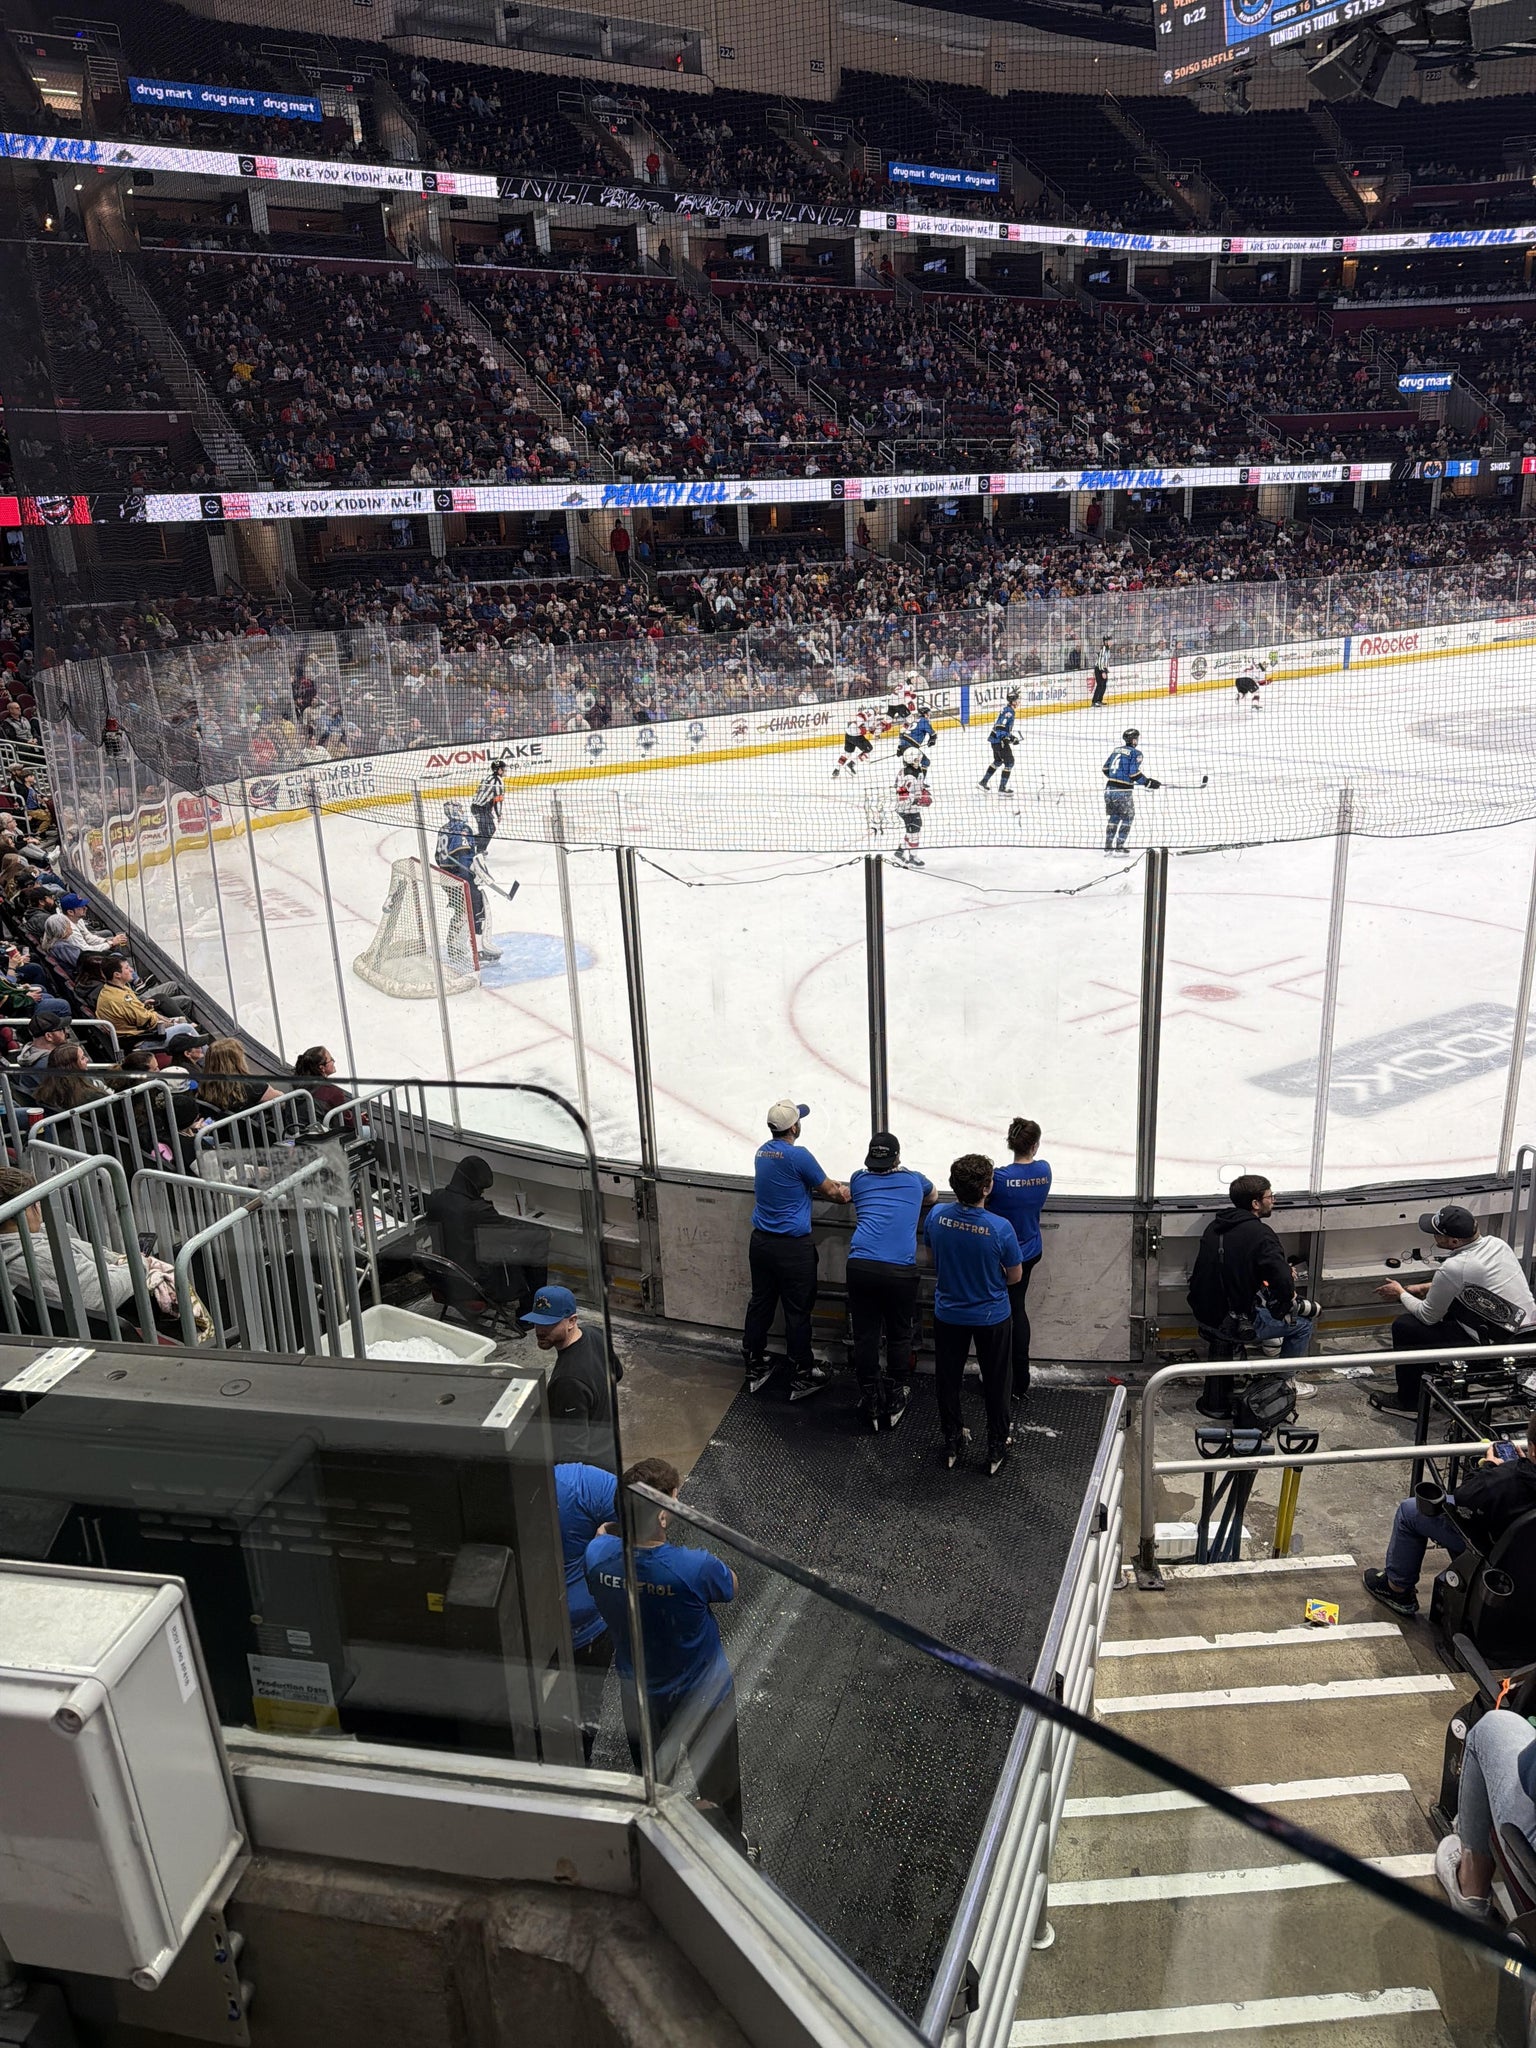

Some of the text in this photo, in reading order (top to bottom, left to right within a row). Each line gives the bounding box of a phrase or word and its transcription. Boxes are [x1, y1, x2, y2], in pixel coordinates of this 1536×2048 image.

[1159, 7, 1206, 34] 12 0:22
[1273, 7, 1297, 22] SHOTS
[1299, 1, 1310, 13] 16
[1269, 20, 1311, 47] TONIGHT'S
[1313, 10, 1339, 31] TOTAL
[721, 48, 735, 58] 224
[811, 61, 824, 71] 225
[1174, 62, 1200, 79] 50/50
[1201, 49, 1234, 69] RAFFLE
[136, 83, 315, 113] drug mart drug mart drug mart
[290, 165, 313, 178] ARE
[317, 168, 339, 180] YOU
[344, 170, 381, 183] KIDDIN'
[387, 171, 412, 187] ME!!
[893, 166, 995, 186] drug mart drug mart drug mart
[916, 221, 931, 231] ARE
[934, 223, 948, 232] YOU
[1250, 242, 1264, 251] ARE
[1267, 241, 1280, 250] YOU
[1398, 374, 1452, 390] drug mart
[1267, 472, 1280, 481] ARE
[1283, 471, 1295, 481] YOU
[1459, 462, 1472, 475] 16
[1490, 462, 1510, 472] SHOTS
[871, 484, 889, 495] ARE
[894, 482, 911, 493] YOU
[950, 477, 970, 491] ME!!
[1079, 470, 1164, 490] PENALTY KILL
[267, 500, 295, 514] ARE
[302, 500, 328, 512] YOU
[335, 498, 382, 511] KIDDIN'
[391, 491, 422, 509] ME!!
[601, 481, 730, 508] PENALTY KILL
[1373, 632, 1419, 656] Rocket
[1434, 636, 1447, 648] nrg
[1466, 631, 1480, 644] nrg
[1046, 687, 1067, 701] slaps
[1110, 753, 1121, 775] 4
[324, 778, 375, 801] JACKETS
[256, 1679, 328, 1694] Production Date
[1455, 1725, 1462, 1734] 5
